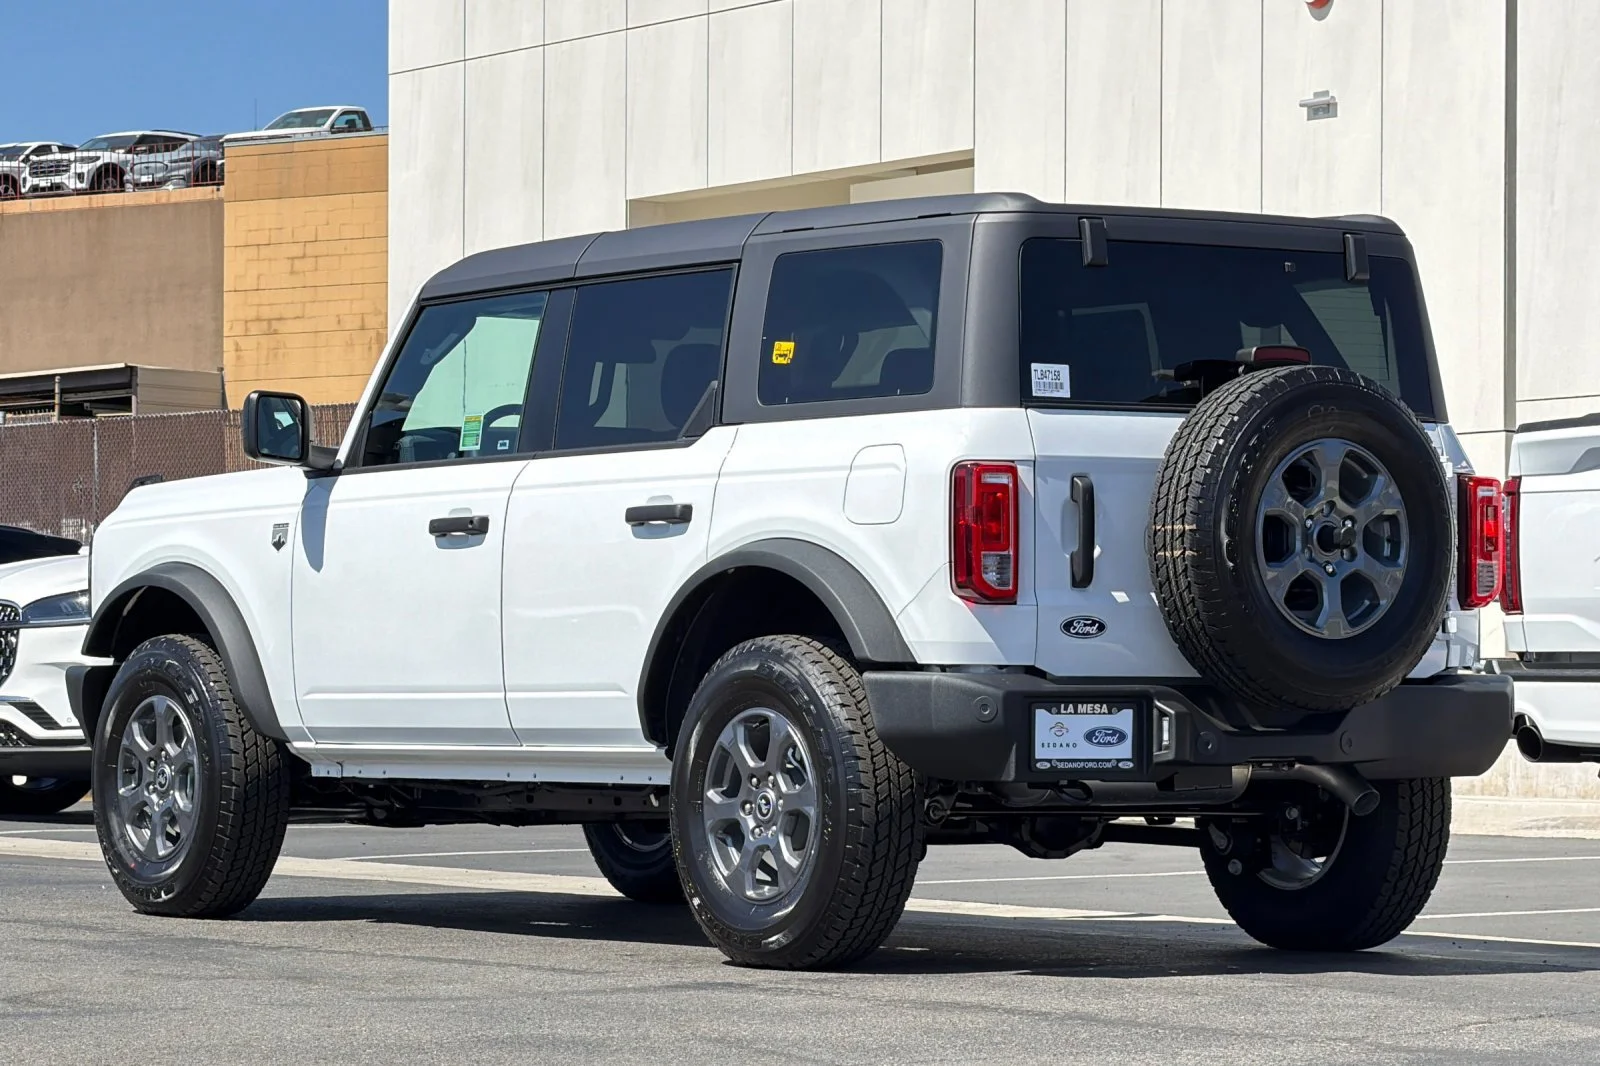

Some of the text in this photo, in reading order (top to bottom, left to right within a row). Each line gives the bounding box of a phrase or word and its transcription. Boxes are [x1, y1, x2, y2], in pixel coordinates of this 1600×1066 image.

[1070, 619, 1099, 634] Ford
[1060, 703, 1109, 714] LA MESA
[1092, 729, 1120, 744] Ford
[1056, 761, 1113, 769] SEDANOFORD.COM
